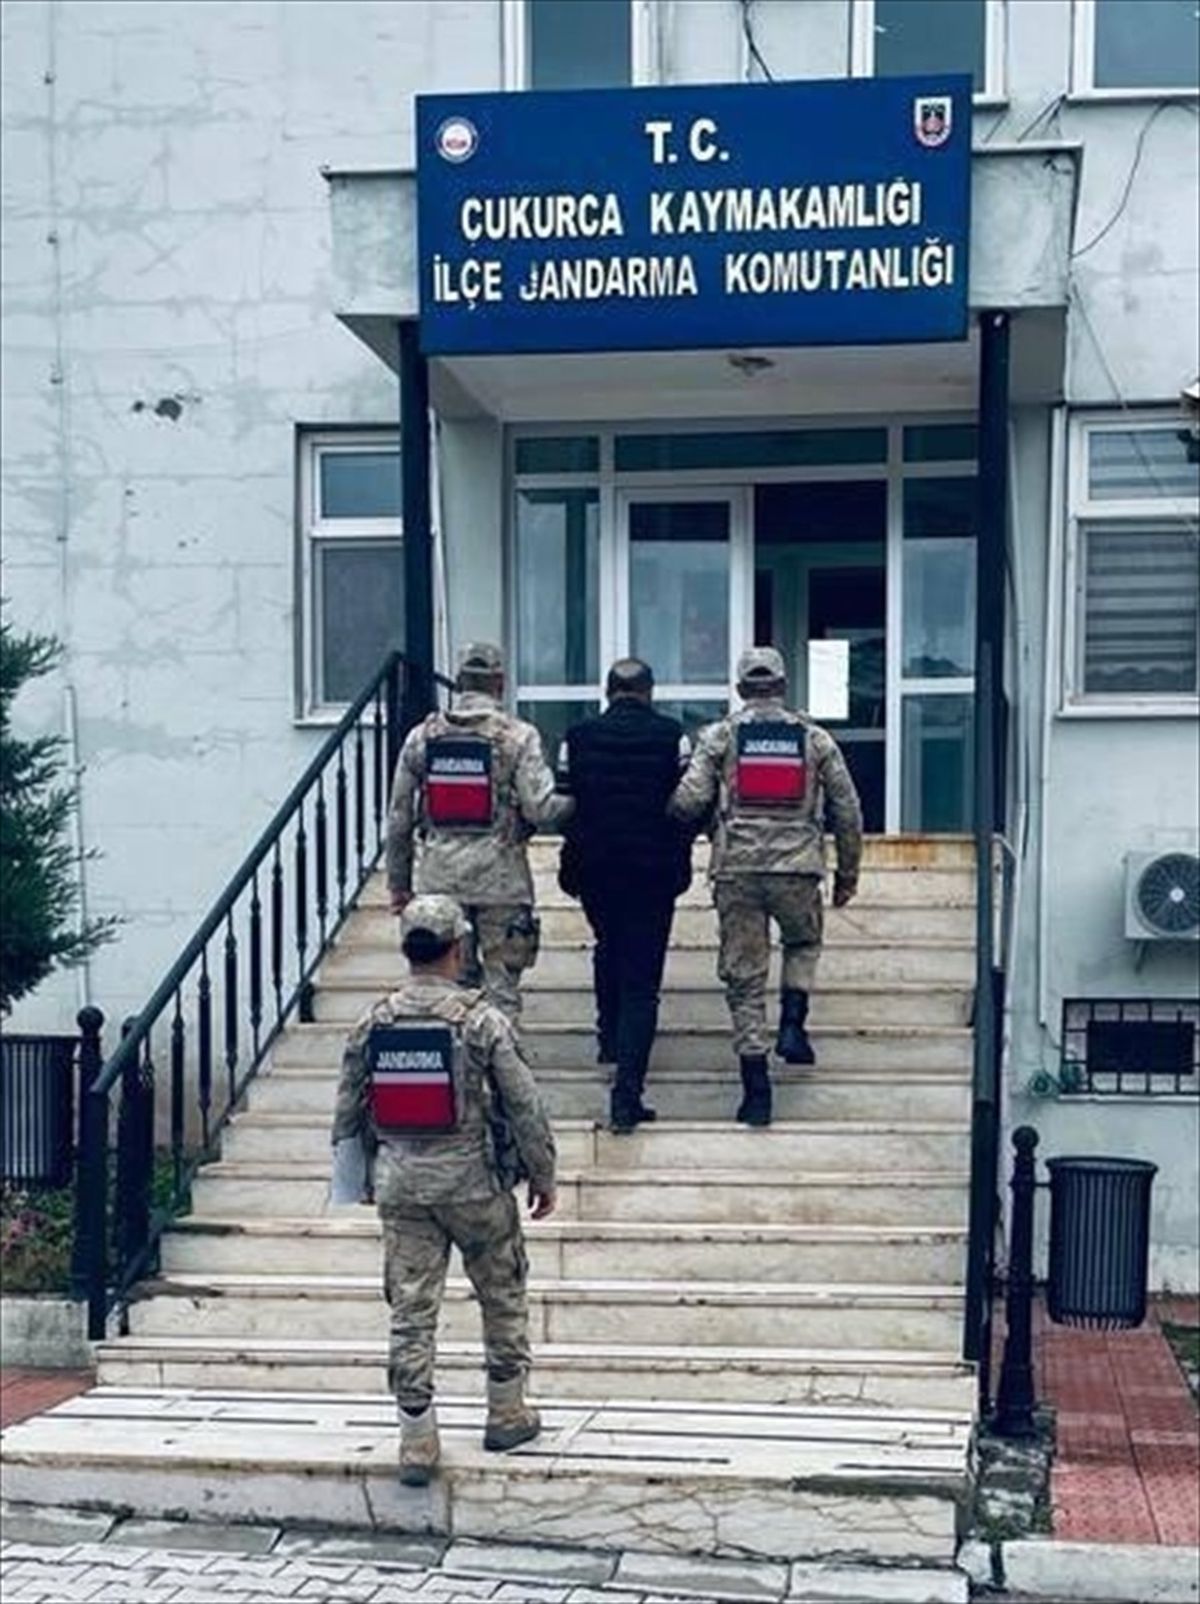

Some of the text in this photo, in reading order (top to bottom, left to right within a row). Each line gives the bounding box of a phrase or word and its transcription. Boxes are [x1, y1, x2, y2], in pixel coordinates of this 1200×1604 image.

[433, 237, 955, 310] İLÇE JANDARMA KOMUTANLIĞI
[376, 1051, 444, 1069] JANDARMA
